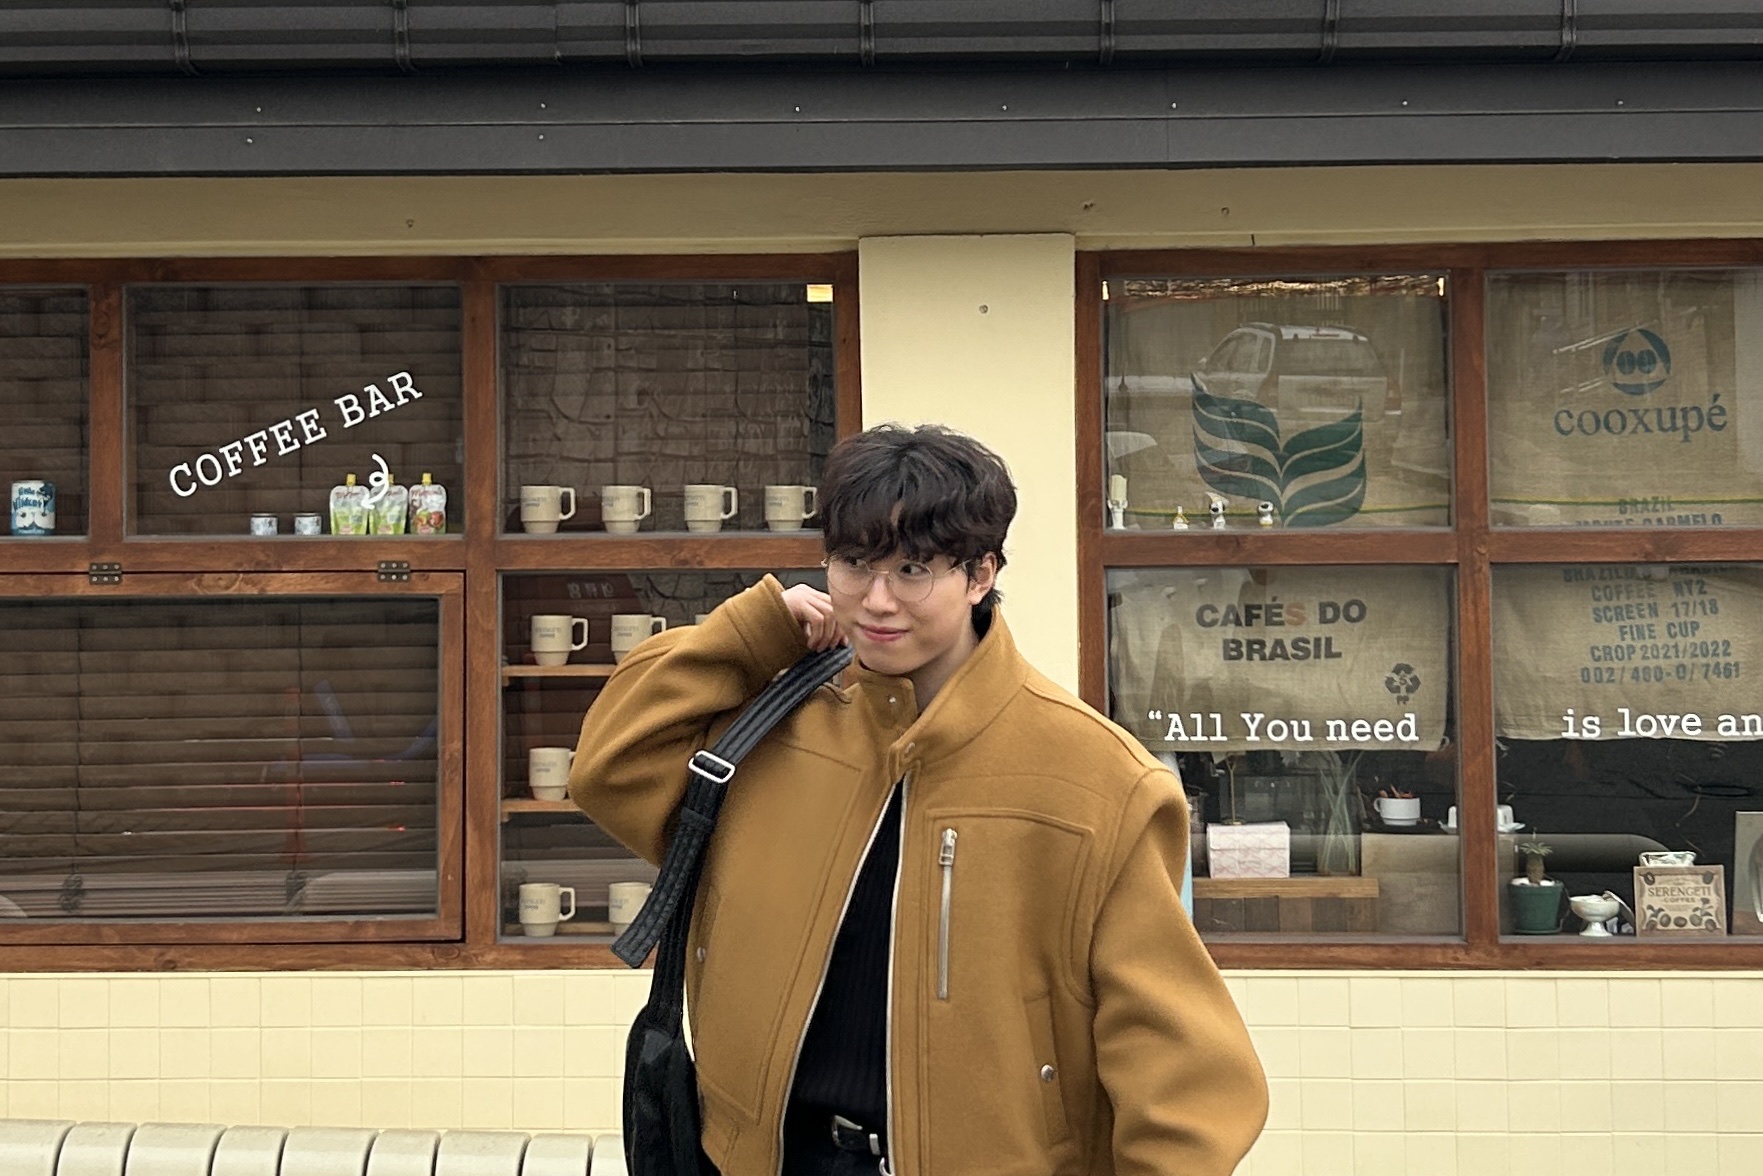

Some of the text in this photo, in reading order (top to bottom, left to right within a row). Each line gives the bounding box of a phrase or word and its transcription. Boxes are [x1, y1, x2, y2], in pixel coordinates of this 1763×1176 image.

[1554, 393, 1728, 443] cooxupé
[169, 371, 423, 497] COFFEE BAR
[1591, 582, 1656, 602] COFFEE
[1195, 596, 1368, 628] CAFÉS DO
[1592, 598, 1720, 623] SCREEN 17/18
[1618, 620, 1701, 641] FINE CUP
[1222, 636, 1343, 662] BRASIL
[1590, 644, 1637, 662] CROP
[1240, 713, 1314, 742] You
[1325, 713, 1420, 742] need
[1561, 708, 1763, 738] is love an
[1647, 886, 1711, 897] SERENGETI
